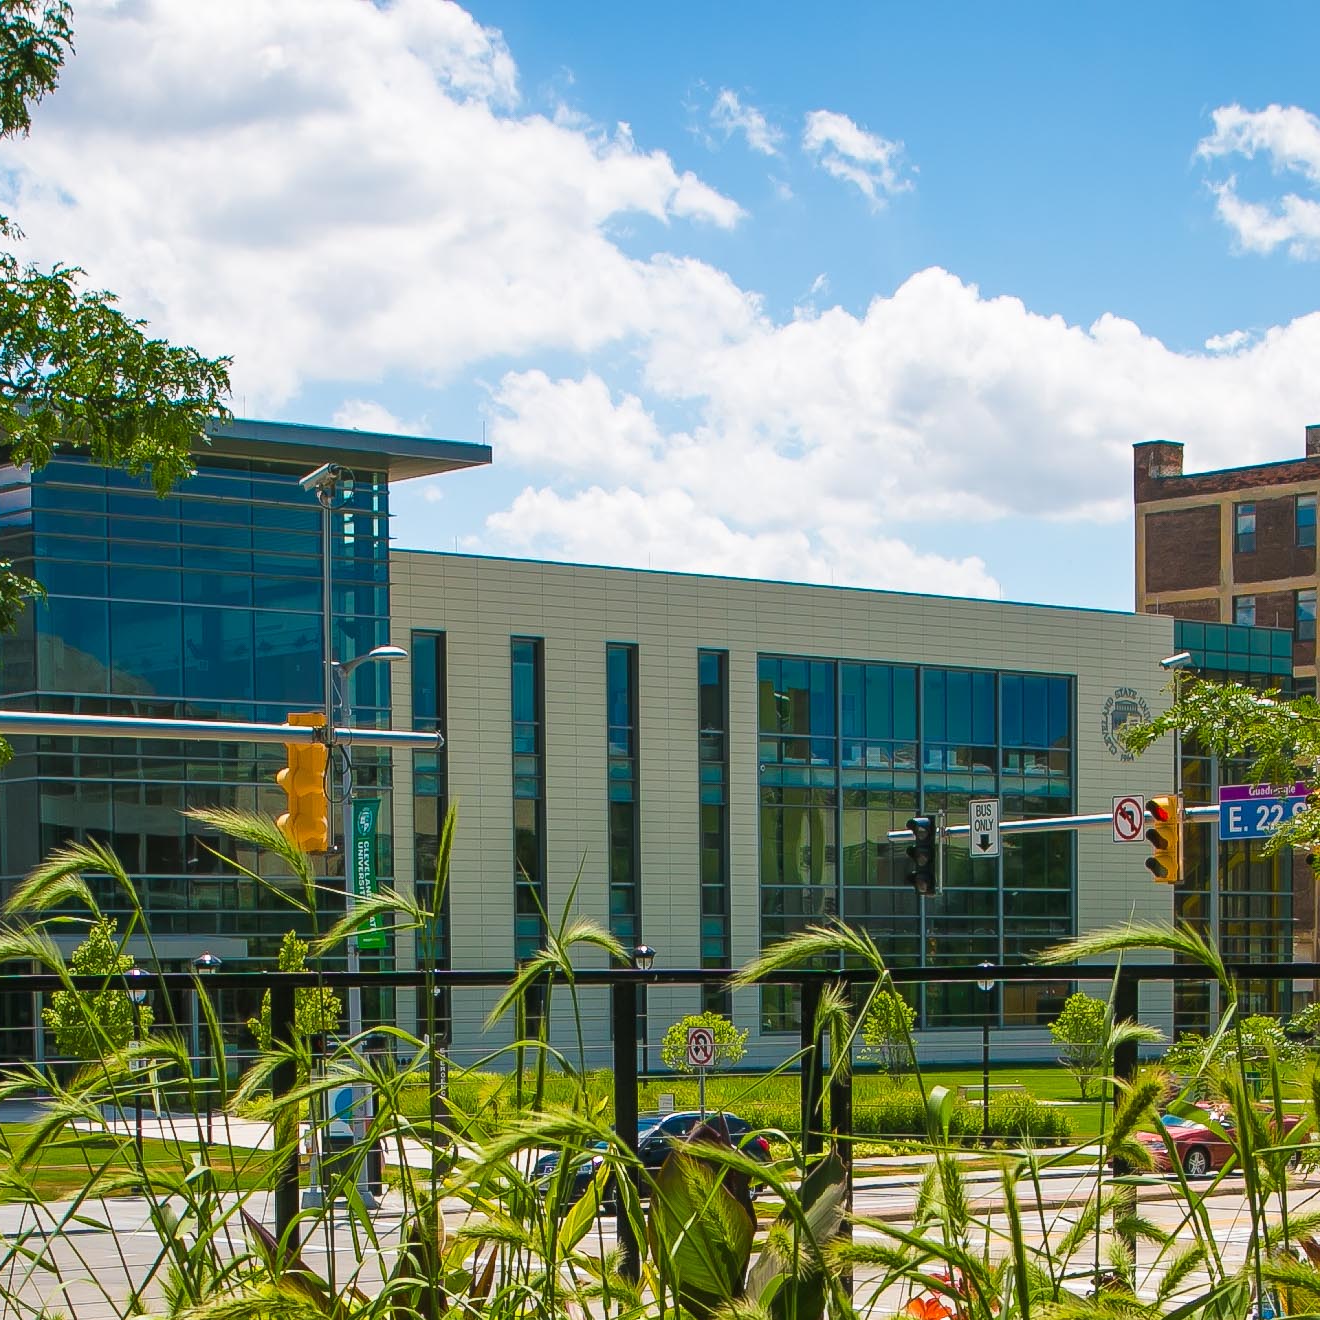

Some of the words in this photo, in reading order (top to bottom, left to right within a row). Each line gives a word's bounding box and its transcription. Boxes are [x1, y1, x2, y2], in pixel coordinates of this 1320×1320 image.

[1248, 784, 1297, 797] Quadrgle
[975, 803, 992, 817] BUS
[974, 818, 994, 833] ONLY
[1229, 805, 1249, 833] E.
[1256, 804, 1284, 832] 22
[357, 841, 366, 896] UNIVERSIT
